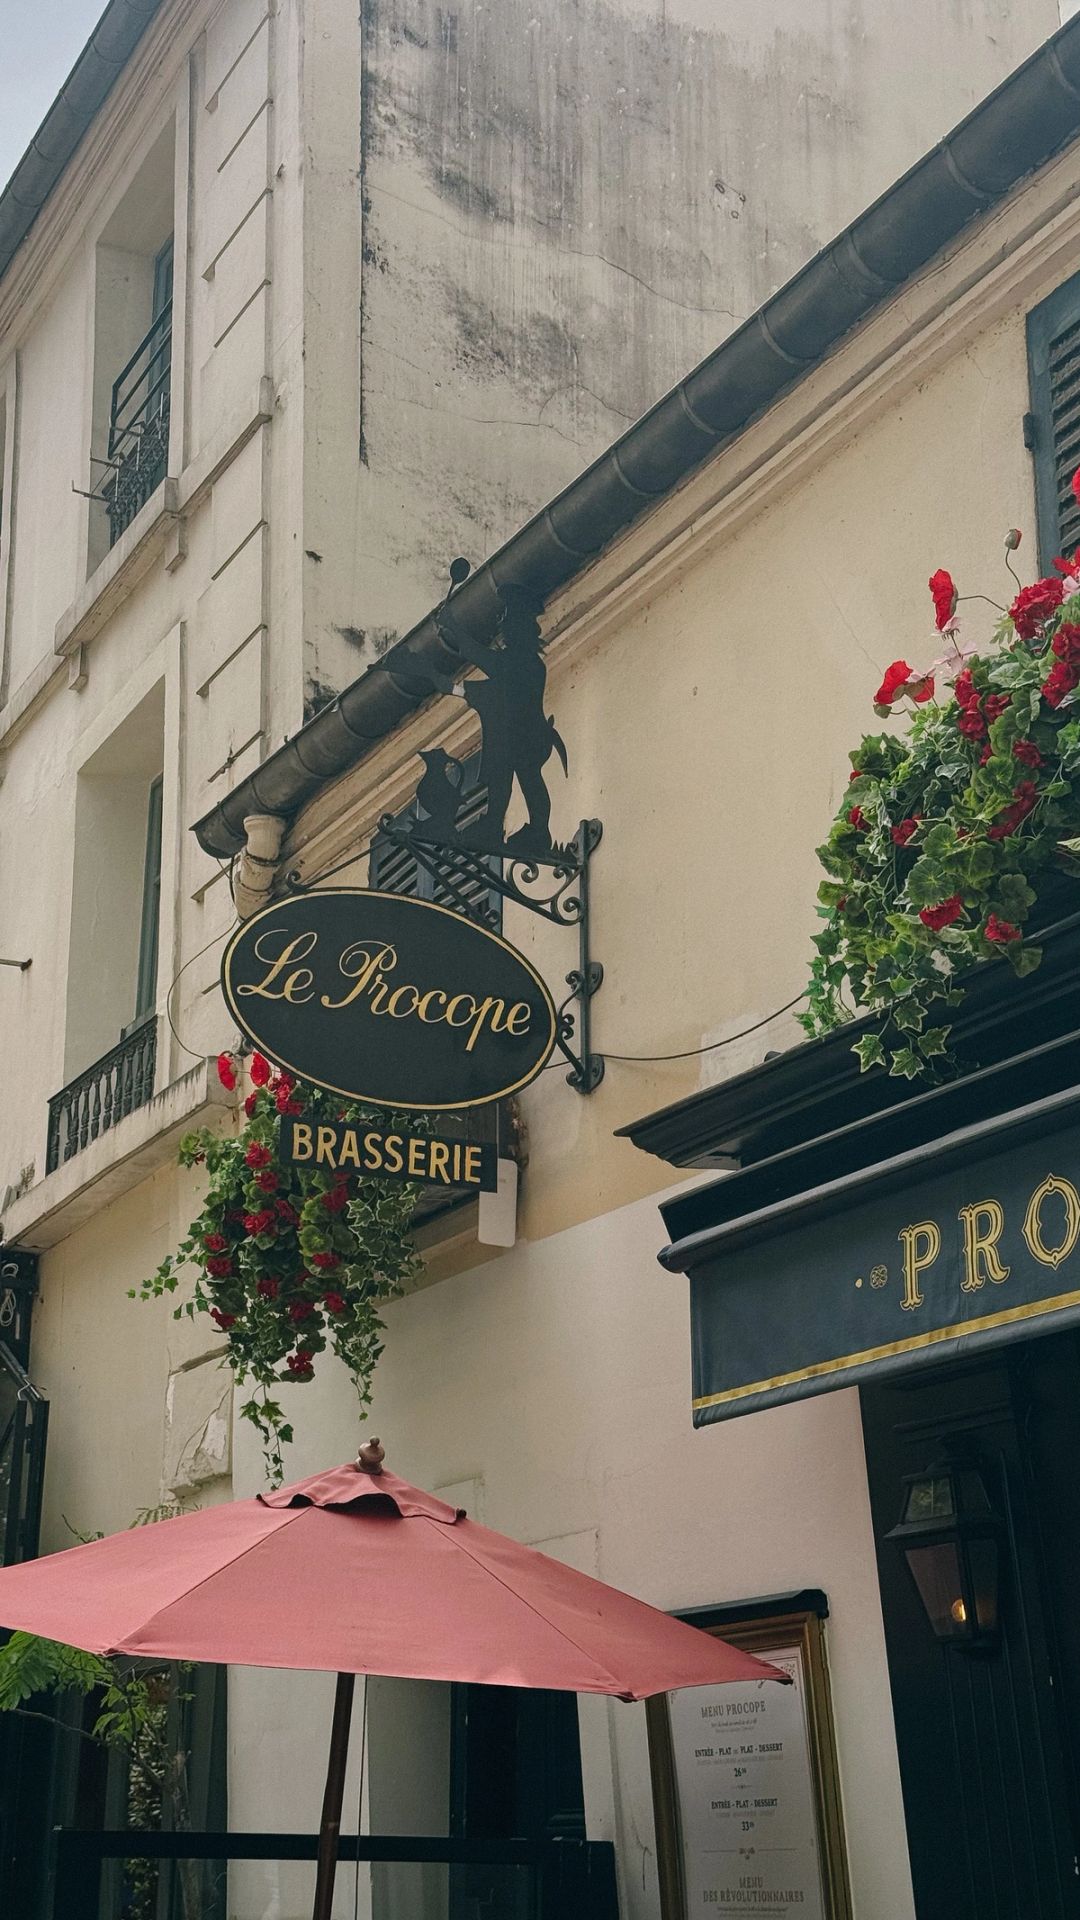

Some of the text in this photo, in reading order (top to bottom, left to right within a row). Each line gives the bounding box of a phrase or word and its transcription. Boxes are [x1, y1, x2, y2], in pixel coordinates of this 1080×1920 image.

[236, 928, 532, 1052] Le Procope
[291, 1122, 482, 1184] BRASSERIE
[898, 1172, 1080, 1311] PRO
[701, 1701, 766, 1718] MENU PROCOPE
[718, 1747, 732, 1756] PLAT
[740, 1745, 753, 1754] PLAT
[759, 1743, 783, 1752] DESSERT
[736, 1800, 749, 1808] PLAT
[754, 1798, 778, 1807] DESSERT
[739, 1876, 764, 1888] MENU
[703, 1888, 804, 1903] DES RÉVOLUTIONNAIRES
